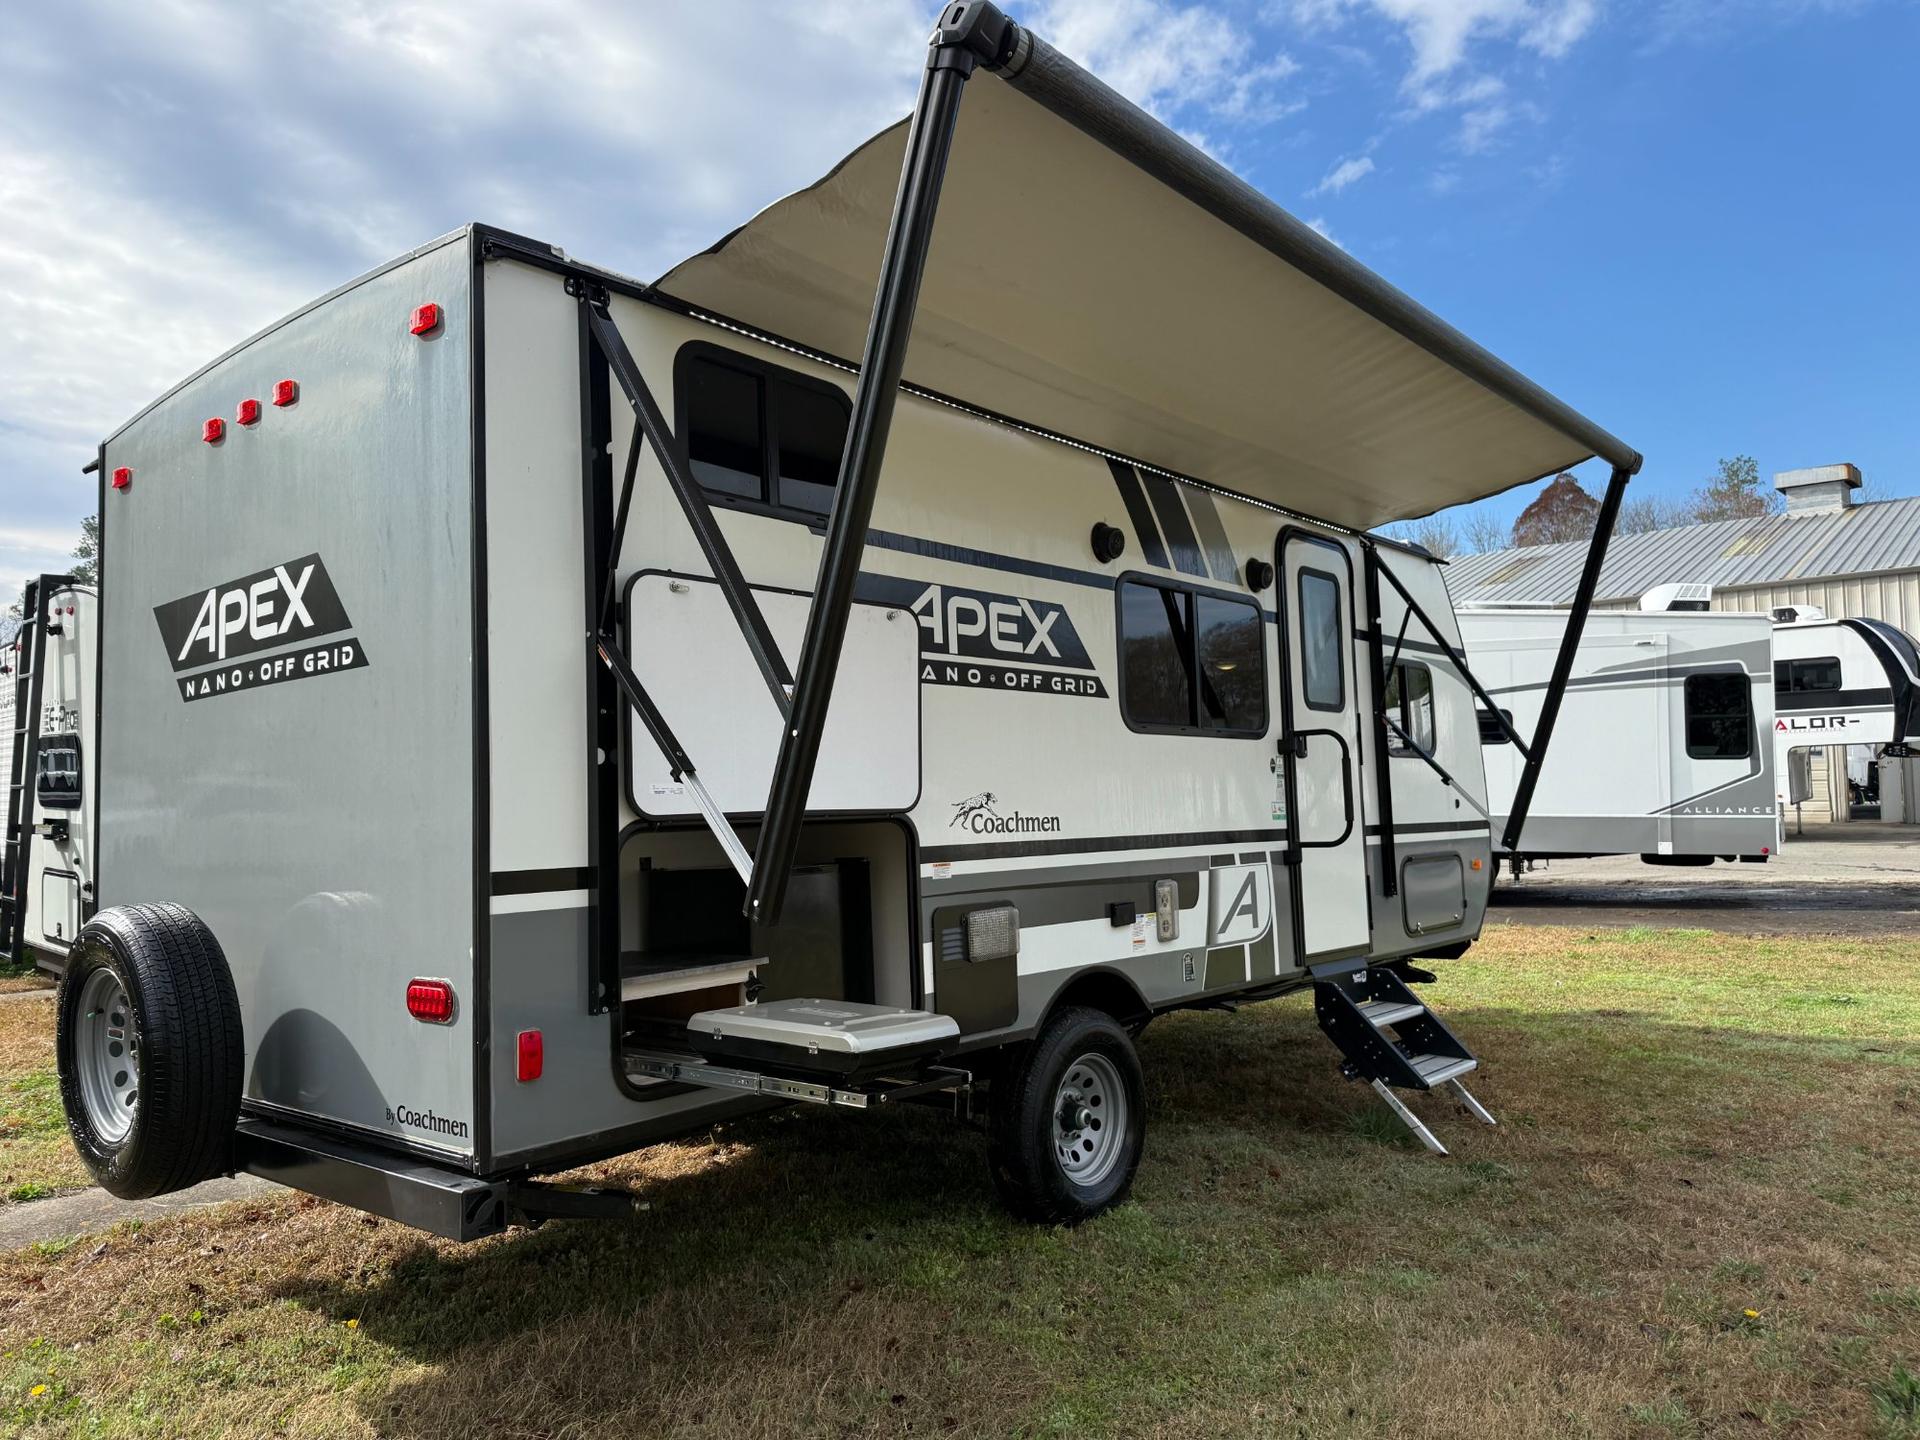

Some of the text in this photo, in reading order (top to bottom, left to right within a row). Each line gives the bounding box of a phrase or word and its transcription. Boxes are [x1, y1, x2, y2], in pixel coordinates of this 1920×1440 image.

[177, 564, 315, 662] APEX
[909, 584, 1062, 659] APEX
[186, 646, 354, 698] NANO OFF GRID
[921, 664, 1097, 695] ANO OFF GRID
[971, 810, 1061, 834] Coachmen
[1682, 806, 1773, 814] ALLIANCE
[385, 1105, 468, 1138] By Coachmen
